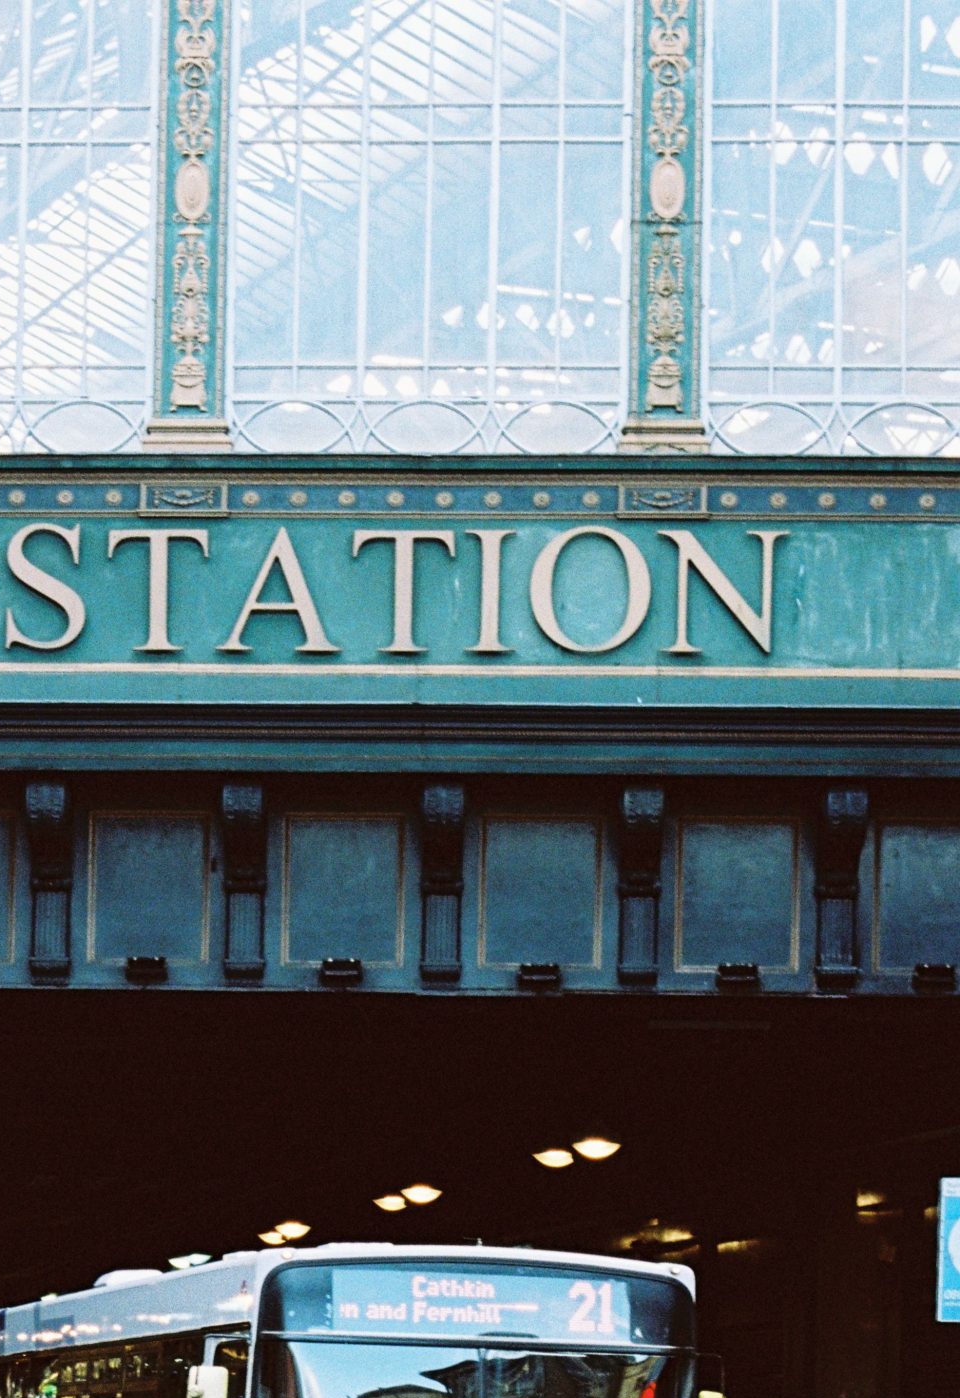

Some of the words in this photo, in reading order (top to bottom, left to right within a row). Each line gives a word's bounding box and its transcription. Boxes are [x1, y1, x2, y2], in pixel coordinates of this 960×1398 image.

[4, 522, 791, 654] STATION
[411, 1275, 496, 1298] Cathkin
[366, 1302, 407, 1321] and
[412, 1301, 501, 1324] Fernhill
[568, 1281, 614, 1333] 21
